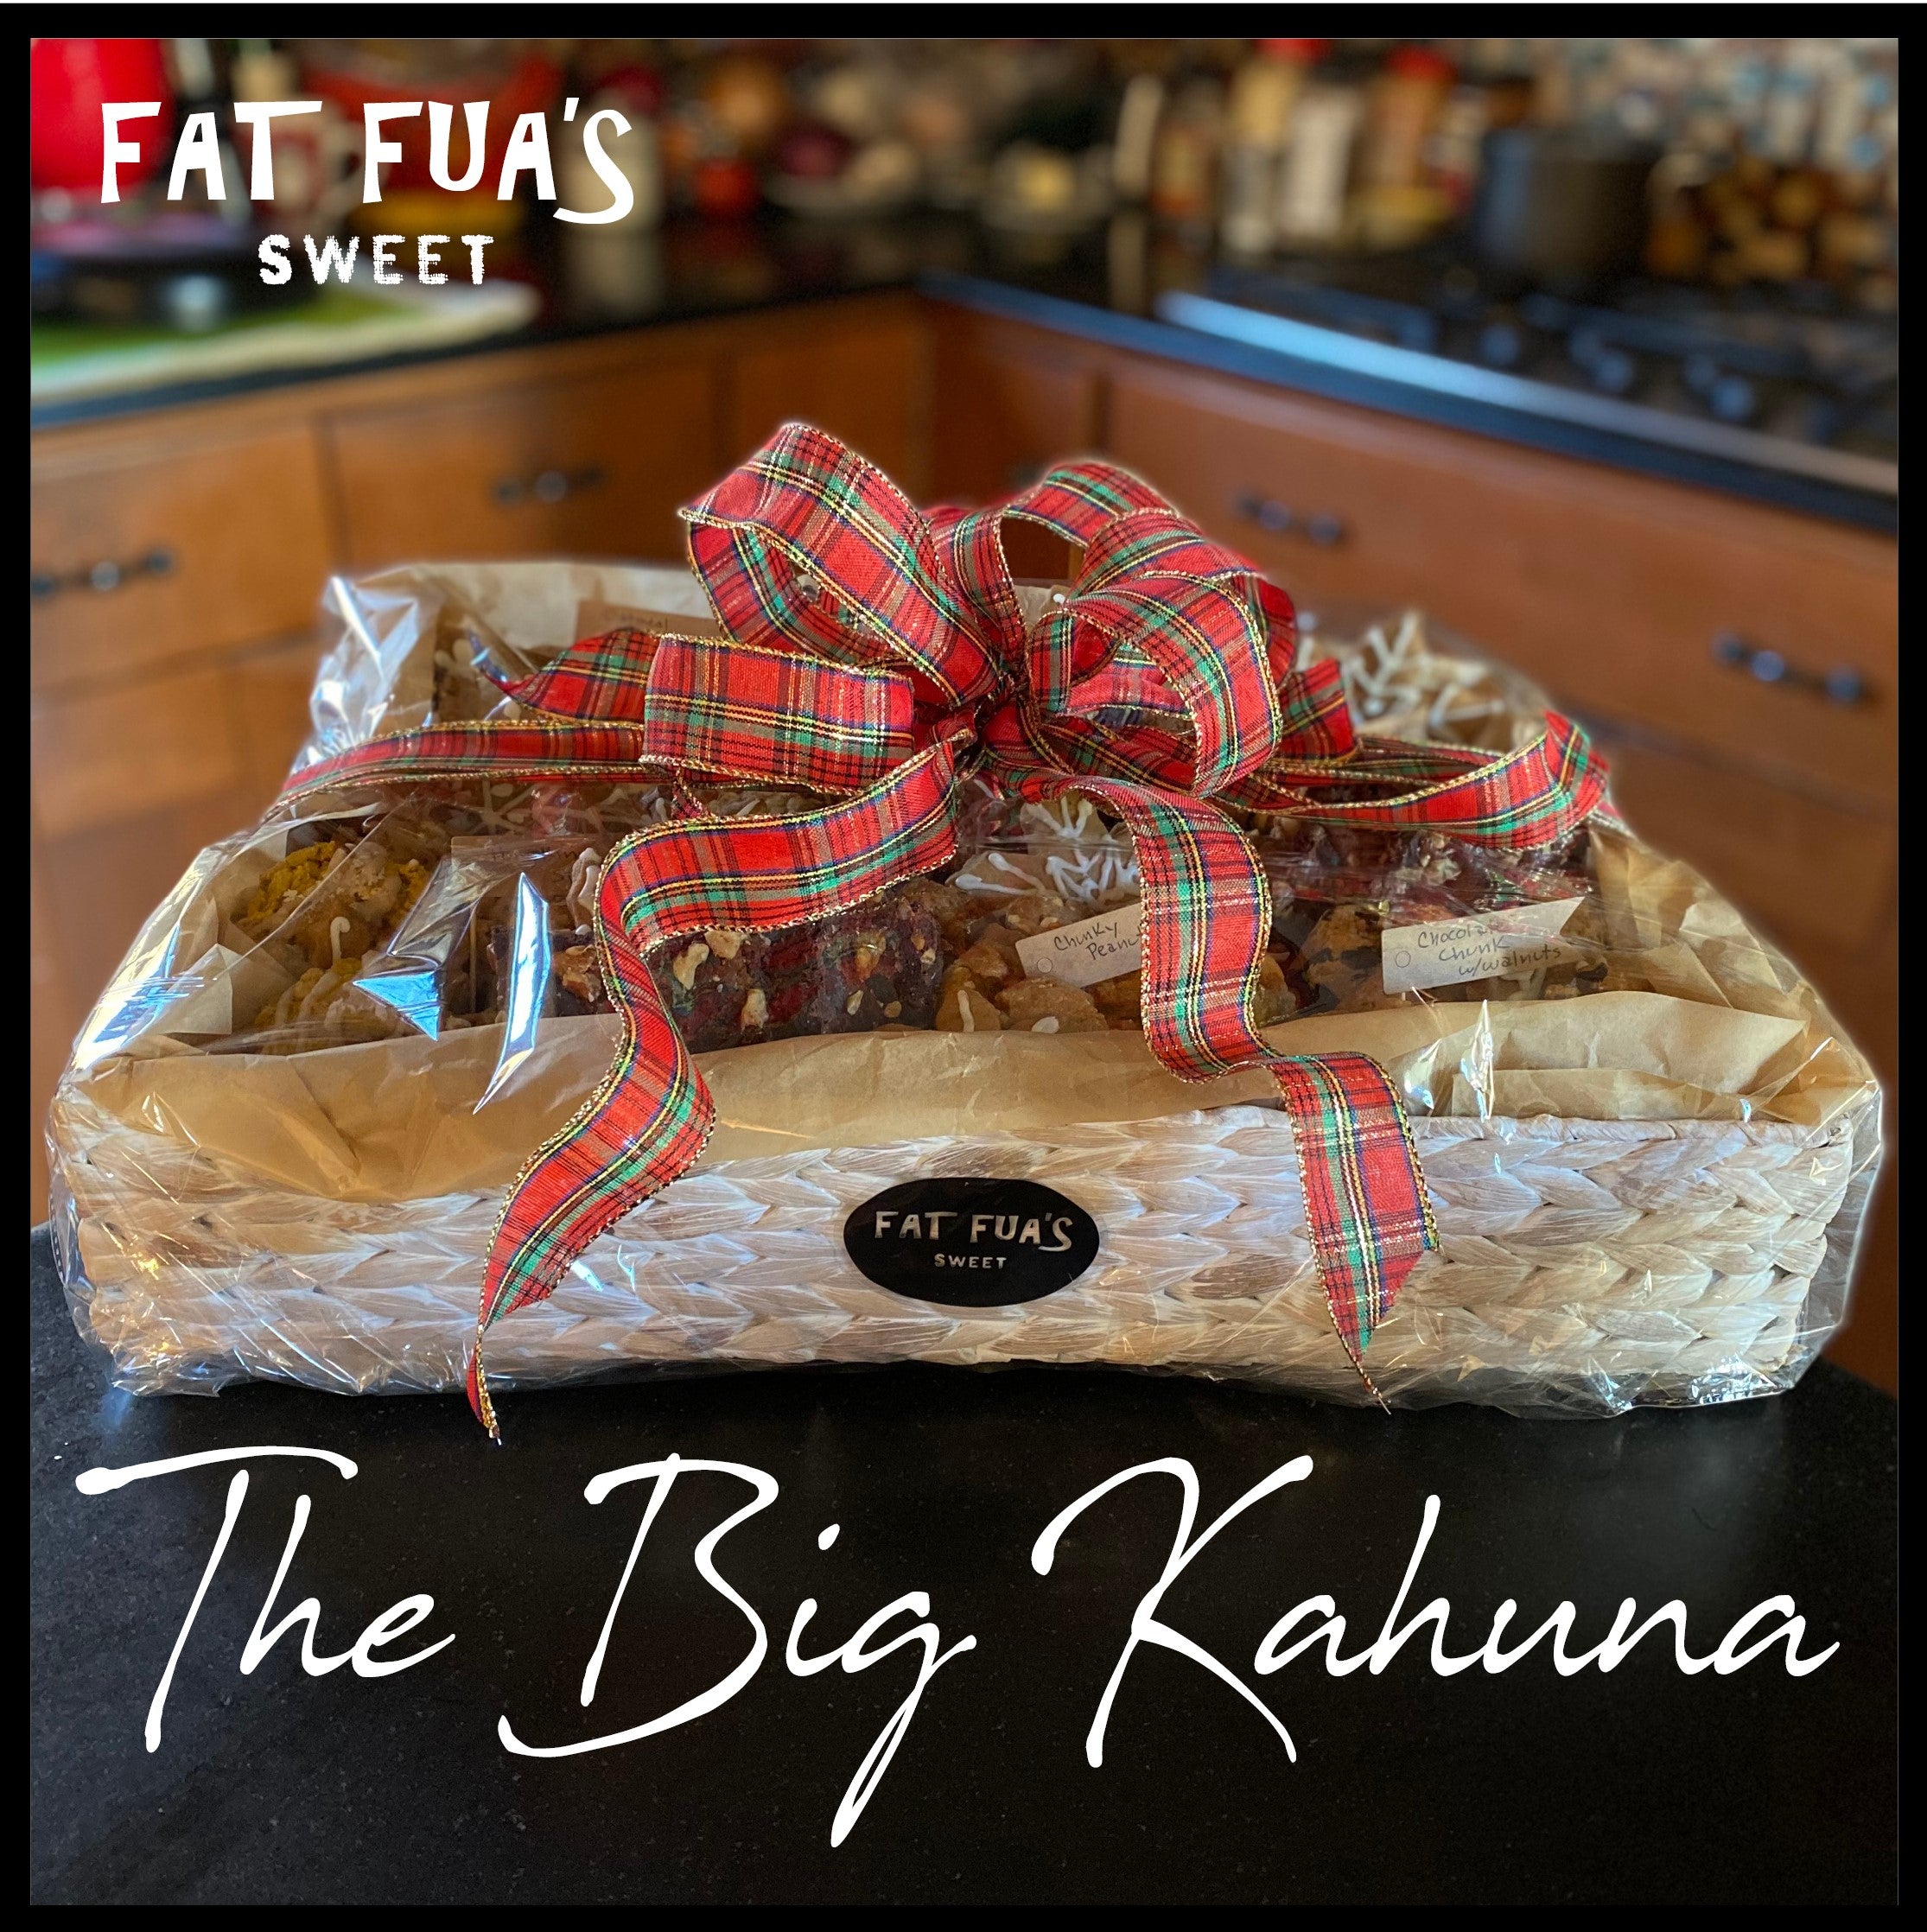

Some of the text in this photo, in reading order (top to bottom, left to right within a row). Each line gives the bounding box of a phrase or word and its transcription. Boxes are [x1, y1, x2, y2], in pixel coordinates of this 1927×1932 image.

[1054, 922, 1117, 950] Chunky
[1418, 925, 1494, 948] Chocola
[874, 1211, 1073, 1252] FAT FUA'S
[934, 1254, 1008, 1269] SWEET
